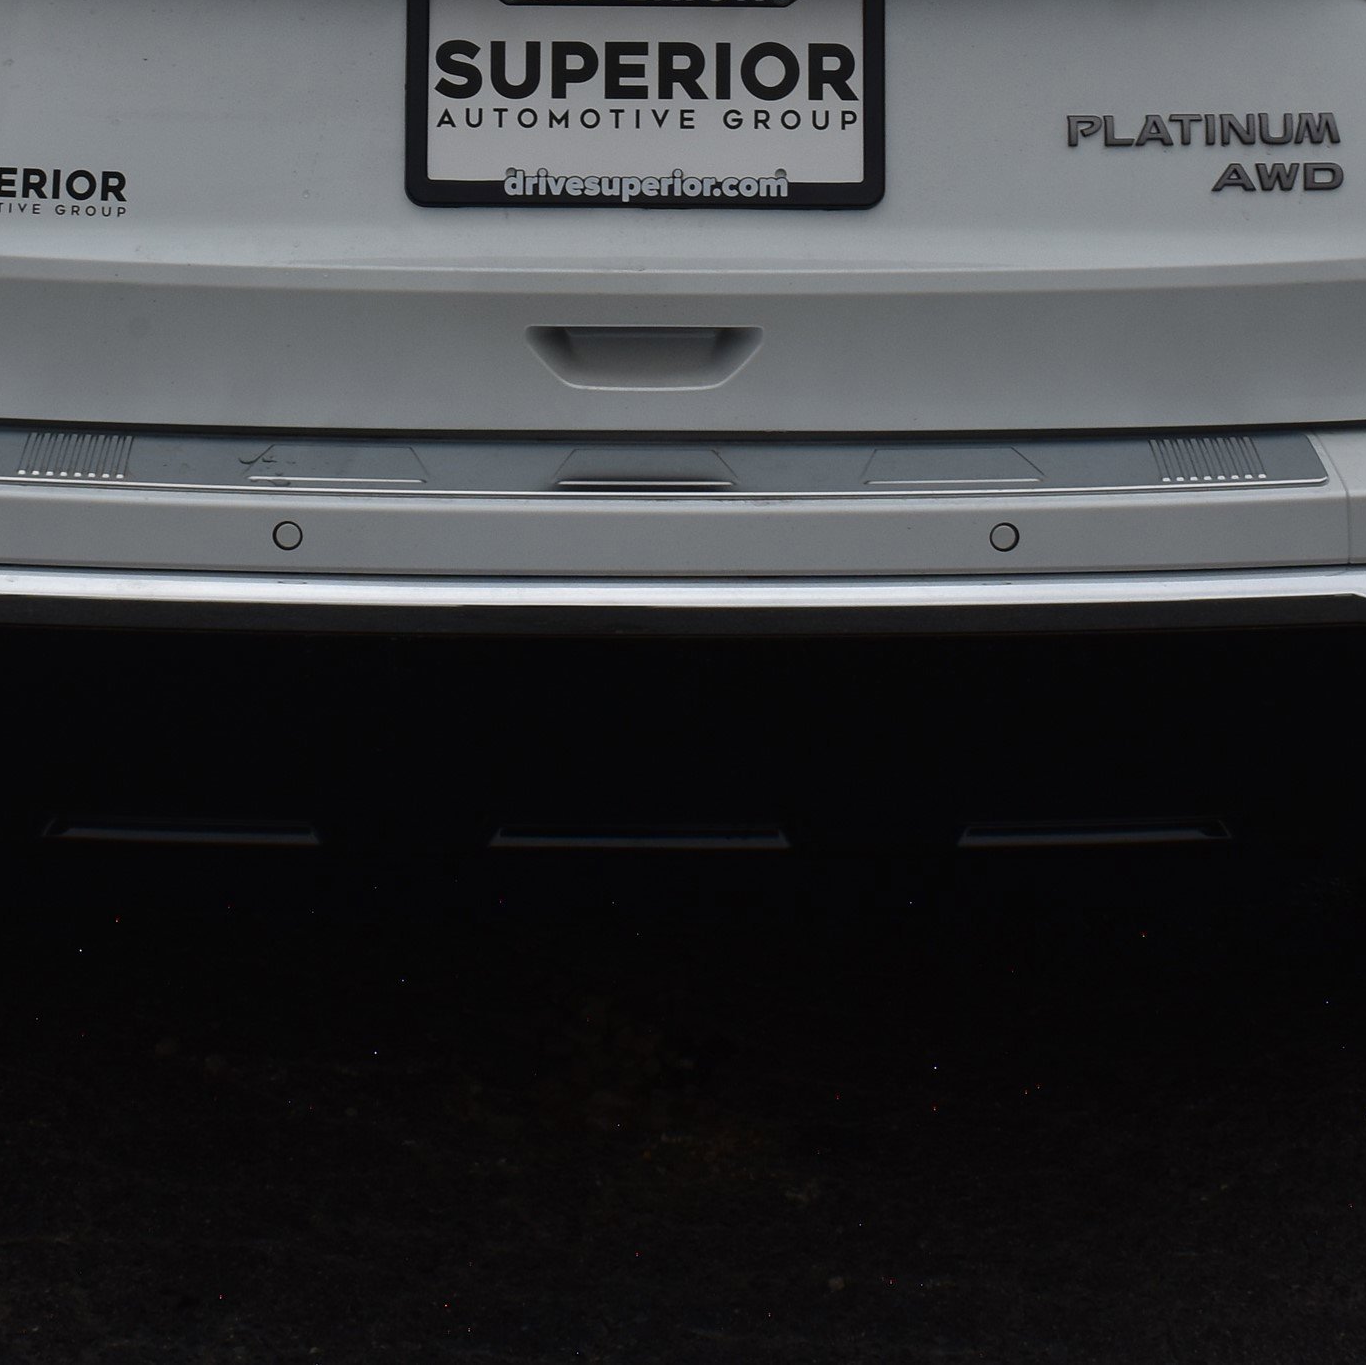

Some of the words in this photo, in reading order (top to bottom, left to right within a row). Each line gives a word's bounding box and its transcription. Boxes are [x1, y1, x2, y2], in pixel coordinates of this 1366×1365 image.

[433, 38, 860, 103] SUPERIOR
[435, 106, 697, 131] AUTOMOTIVE
[722, 108, 858, 132] GROUP
[1066, 112, 1341, 147] PLATINUM
[503, 168, 789, 203] drivesuperior.com
[1211, 162, 1344, 192] AWD
[54, 204, 126, 218] GROUP
